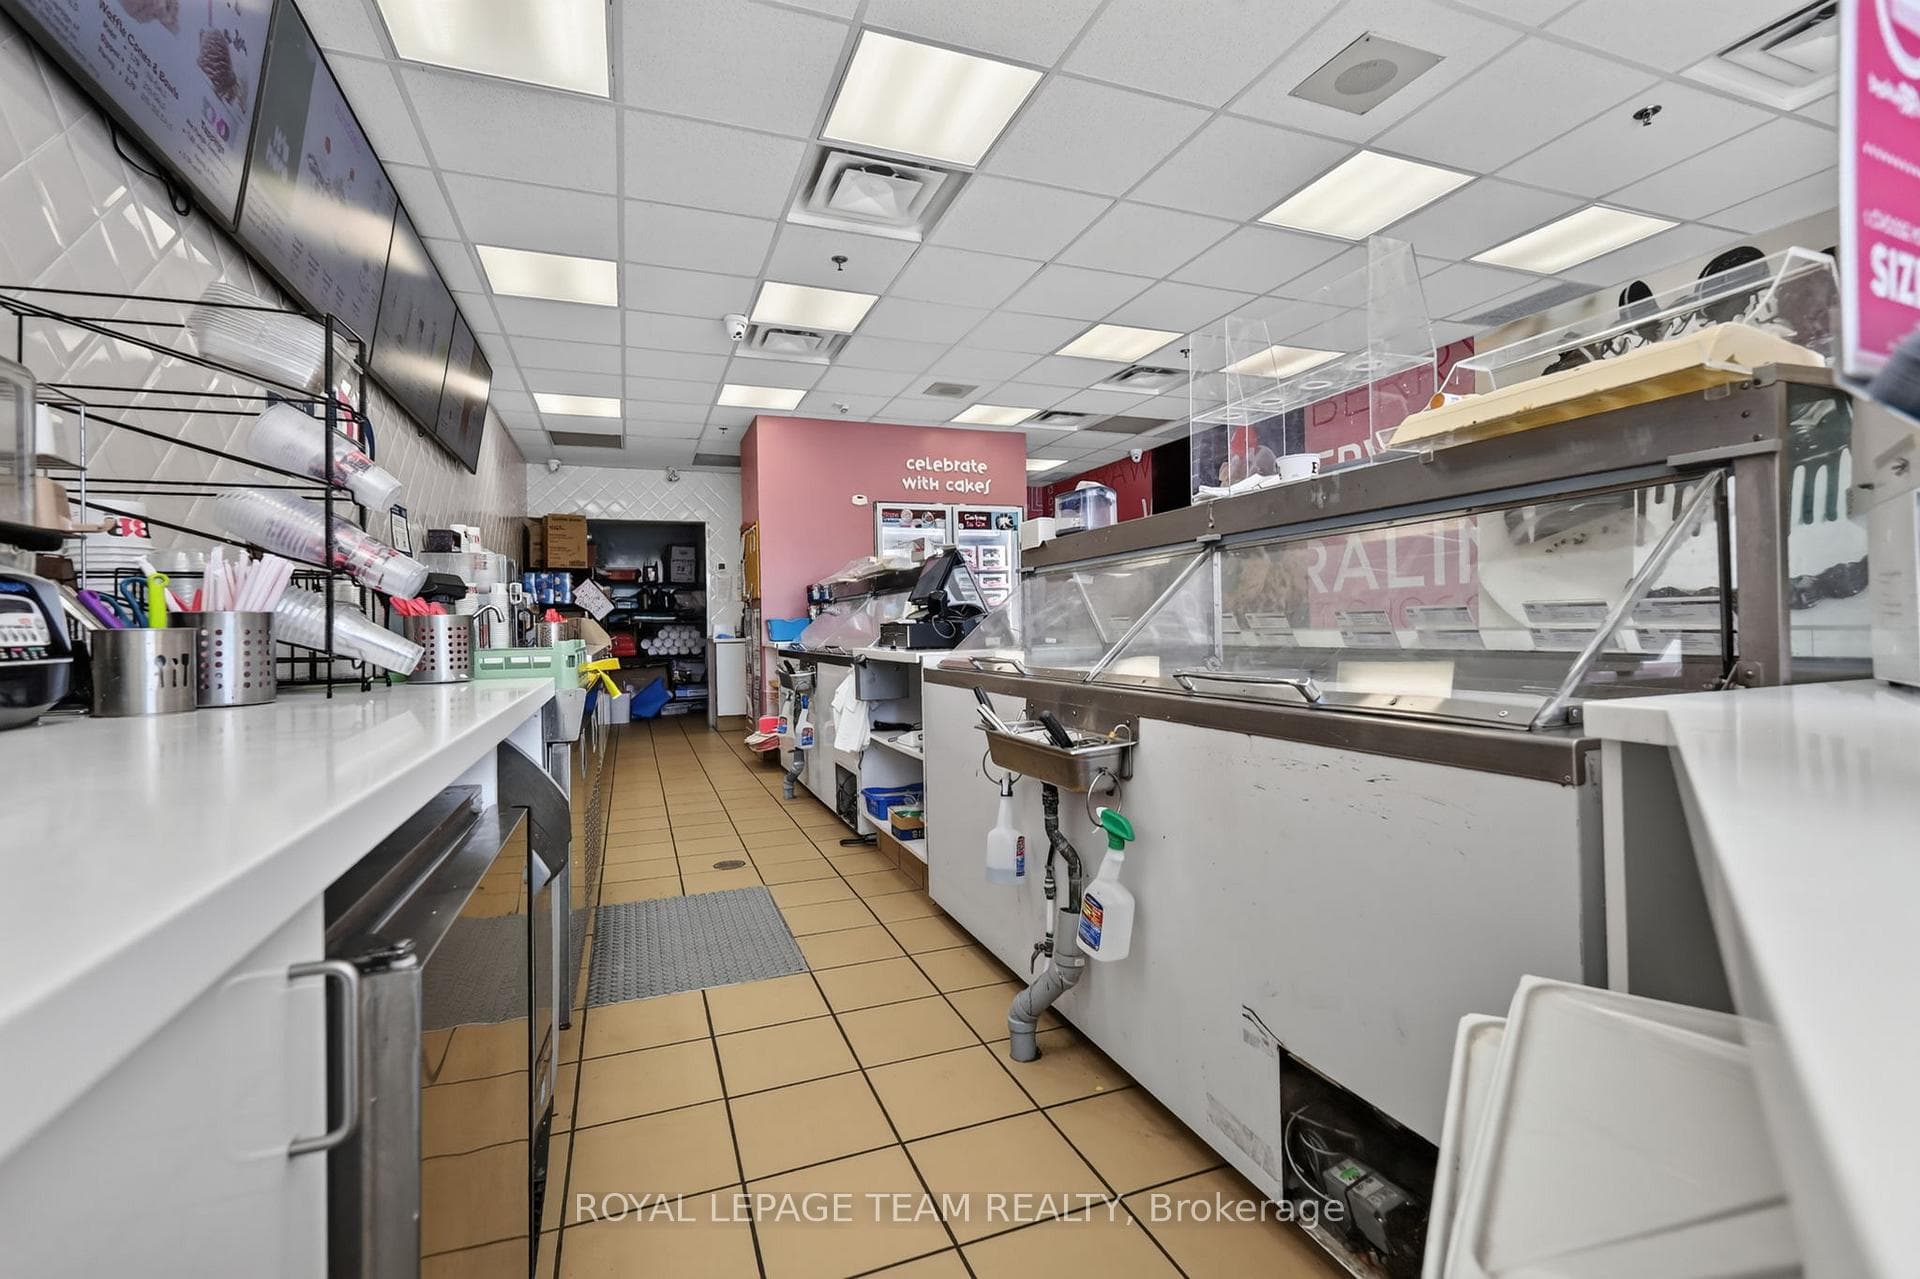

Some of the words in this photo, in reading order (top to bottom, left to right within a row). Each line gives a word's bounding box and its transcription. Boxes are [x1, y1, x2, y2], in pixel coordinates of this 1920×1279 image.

[1869, 241, 1920, 311] SIZ
[906, 456, 988, 474] celebrate
[902, 475, 940, 491] with
[945, 478, 992, 495] cakes
